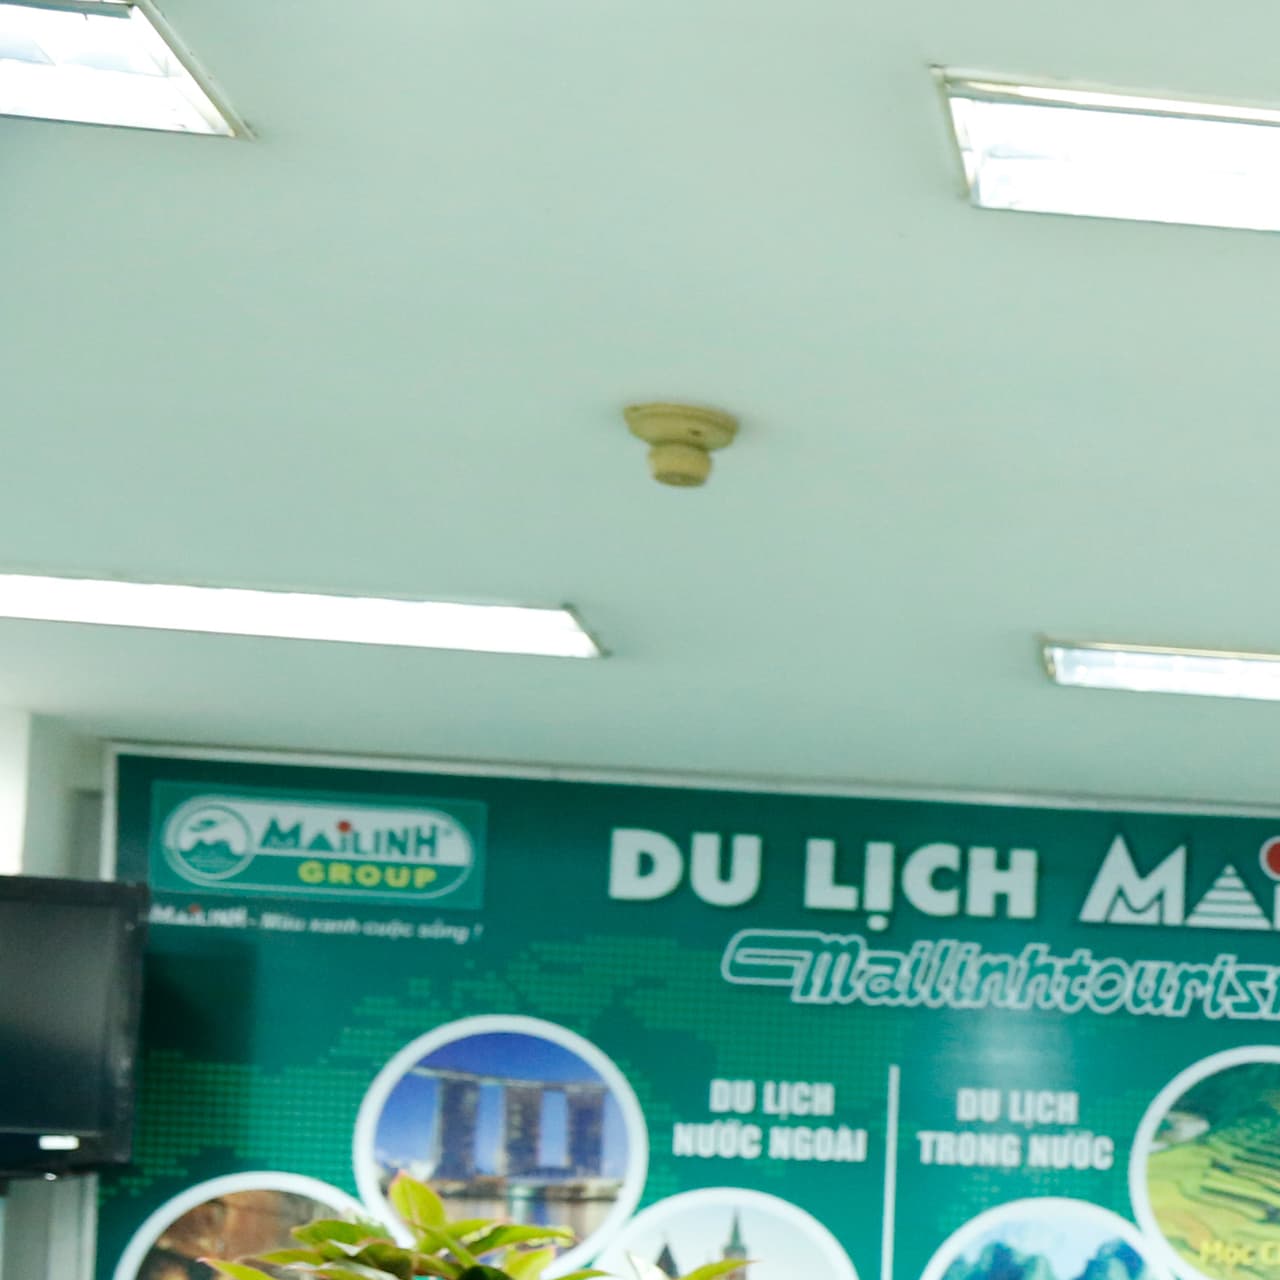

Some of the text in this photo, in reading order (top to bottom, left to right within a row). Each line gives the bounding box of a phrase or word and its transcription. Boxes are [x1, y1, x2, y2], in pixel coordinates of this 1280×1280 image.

[297, 860, 437, 889] GROUP
[608, 828, 762, 906] DU
[804, 838, 1038, 931] LỊCH
[710, 1078, 835, 1119] DU LỊCH
[956, 1087, 1079, 1129] DU LỊCH
[916, 1130, 1021, 1168] TRONG
